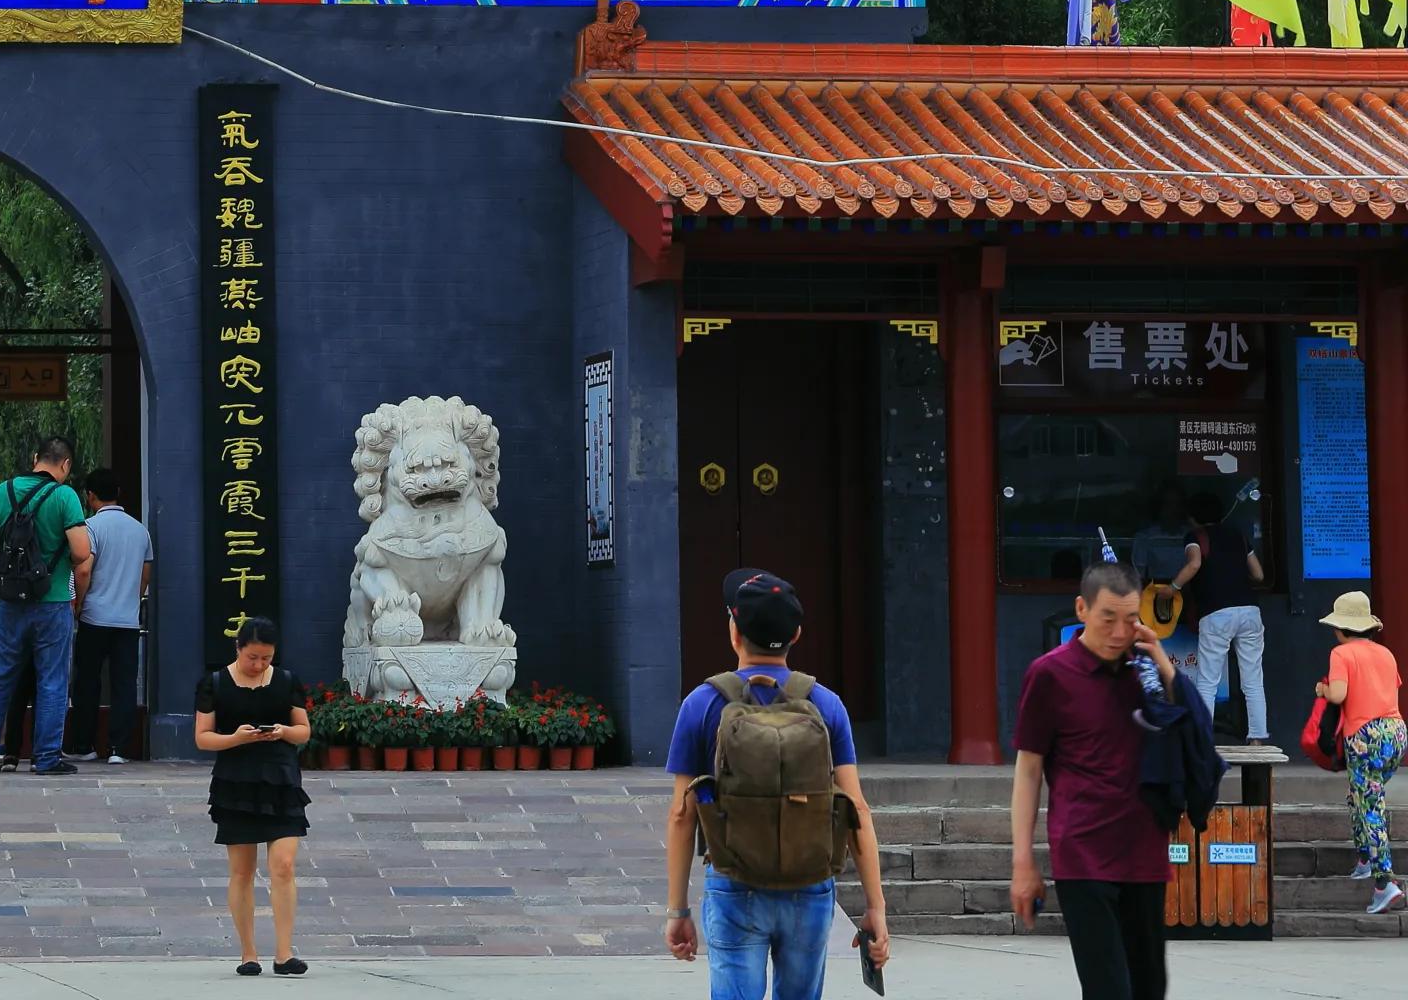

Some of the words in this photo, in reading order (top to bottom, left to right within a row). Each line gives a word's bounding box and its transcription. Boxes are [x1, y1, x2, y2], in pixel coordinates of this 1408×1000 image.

[1083, 320, 1249, 371] 售票处
[20, 367, 53, 381] 入口
[1130, 373, 1204, 386] Tickets
